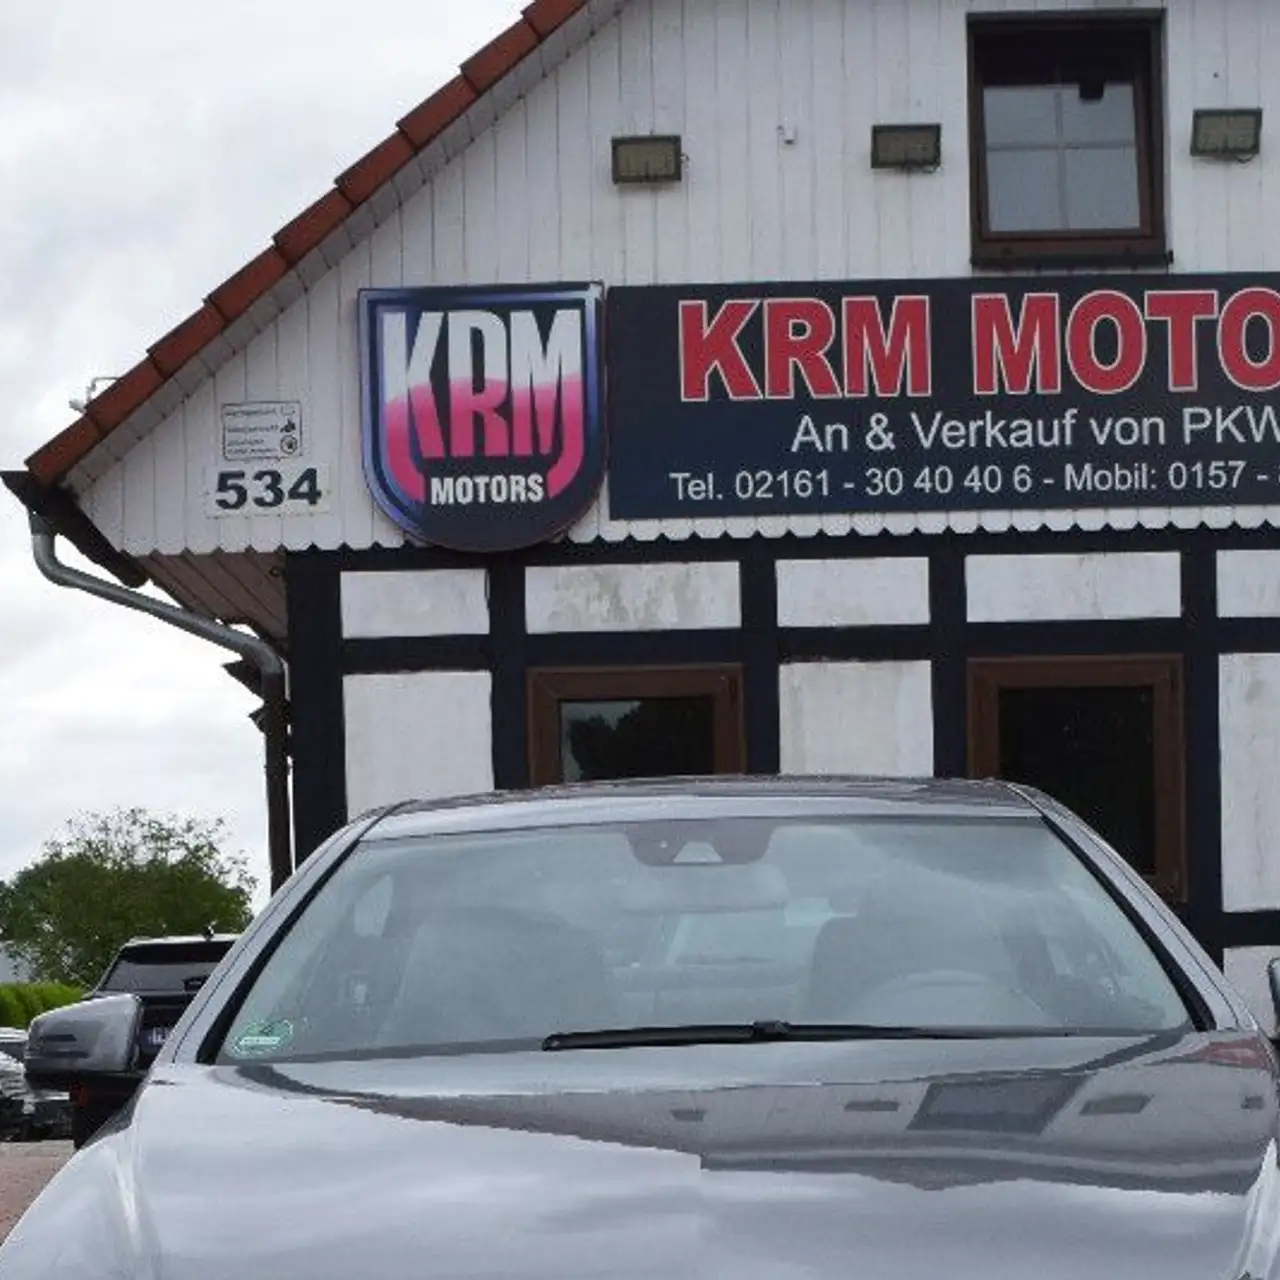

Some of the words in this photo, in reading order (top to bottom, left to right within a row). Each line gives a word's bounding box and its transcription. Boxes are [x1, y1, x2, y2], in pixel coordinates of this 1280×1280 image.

[678, 295, 932, 402] KRM
[383, 309, 583, 502] KRM
[791, 415, 849, 452] An
[865, 412, 896, 450] &
[910, 408, 1078, 449] Verkauf
[1089, 415, 1165, 446] von
[215, 468, 322, 510] 534
[430, 473, 545, 505] MOTORS
[669, 472, 723, 501] Tel.
[736, 469, 829, 499] 02161
[865, 466, 903, 496] 30
[913, 465, 953, 494] 40
[964, 464, 1002, 493] 40
[1013, 464, 1032, 493] 6
[1064, 462, 1157, 491] Mobil:
[1169, 460, 1247, 489] 0157
